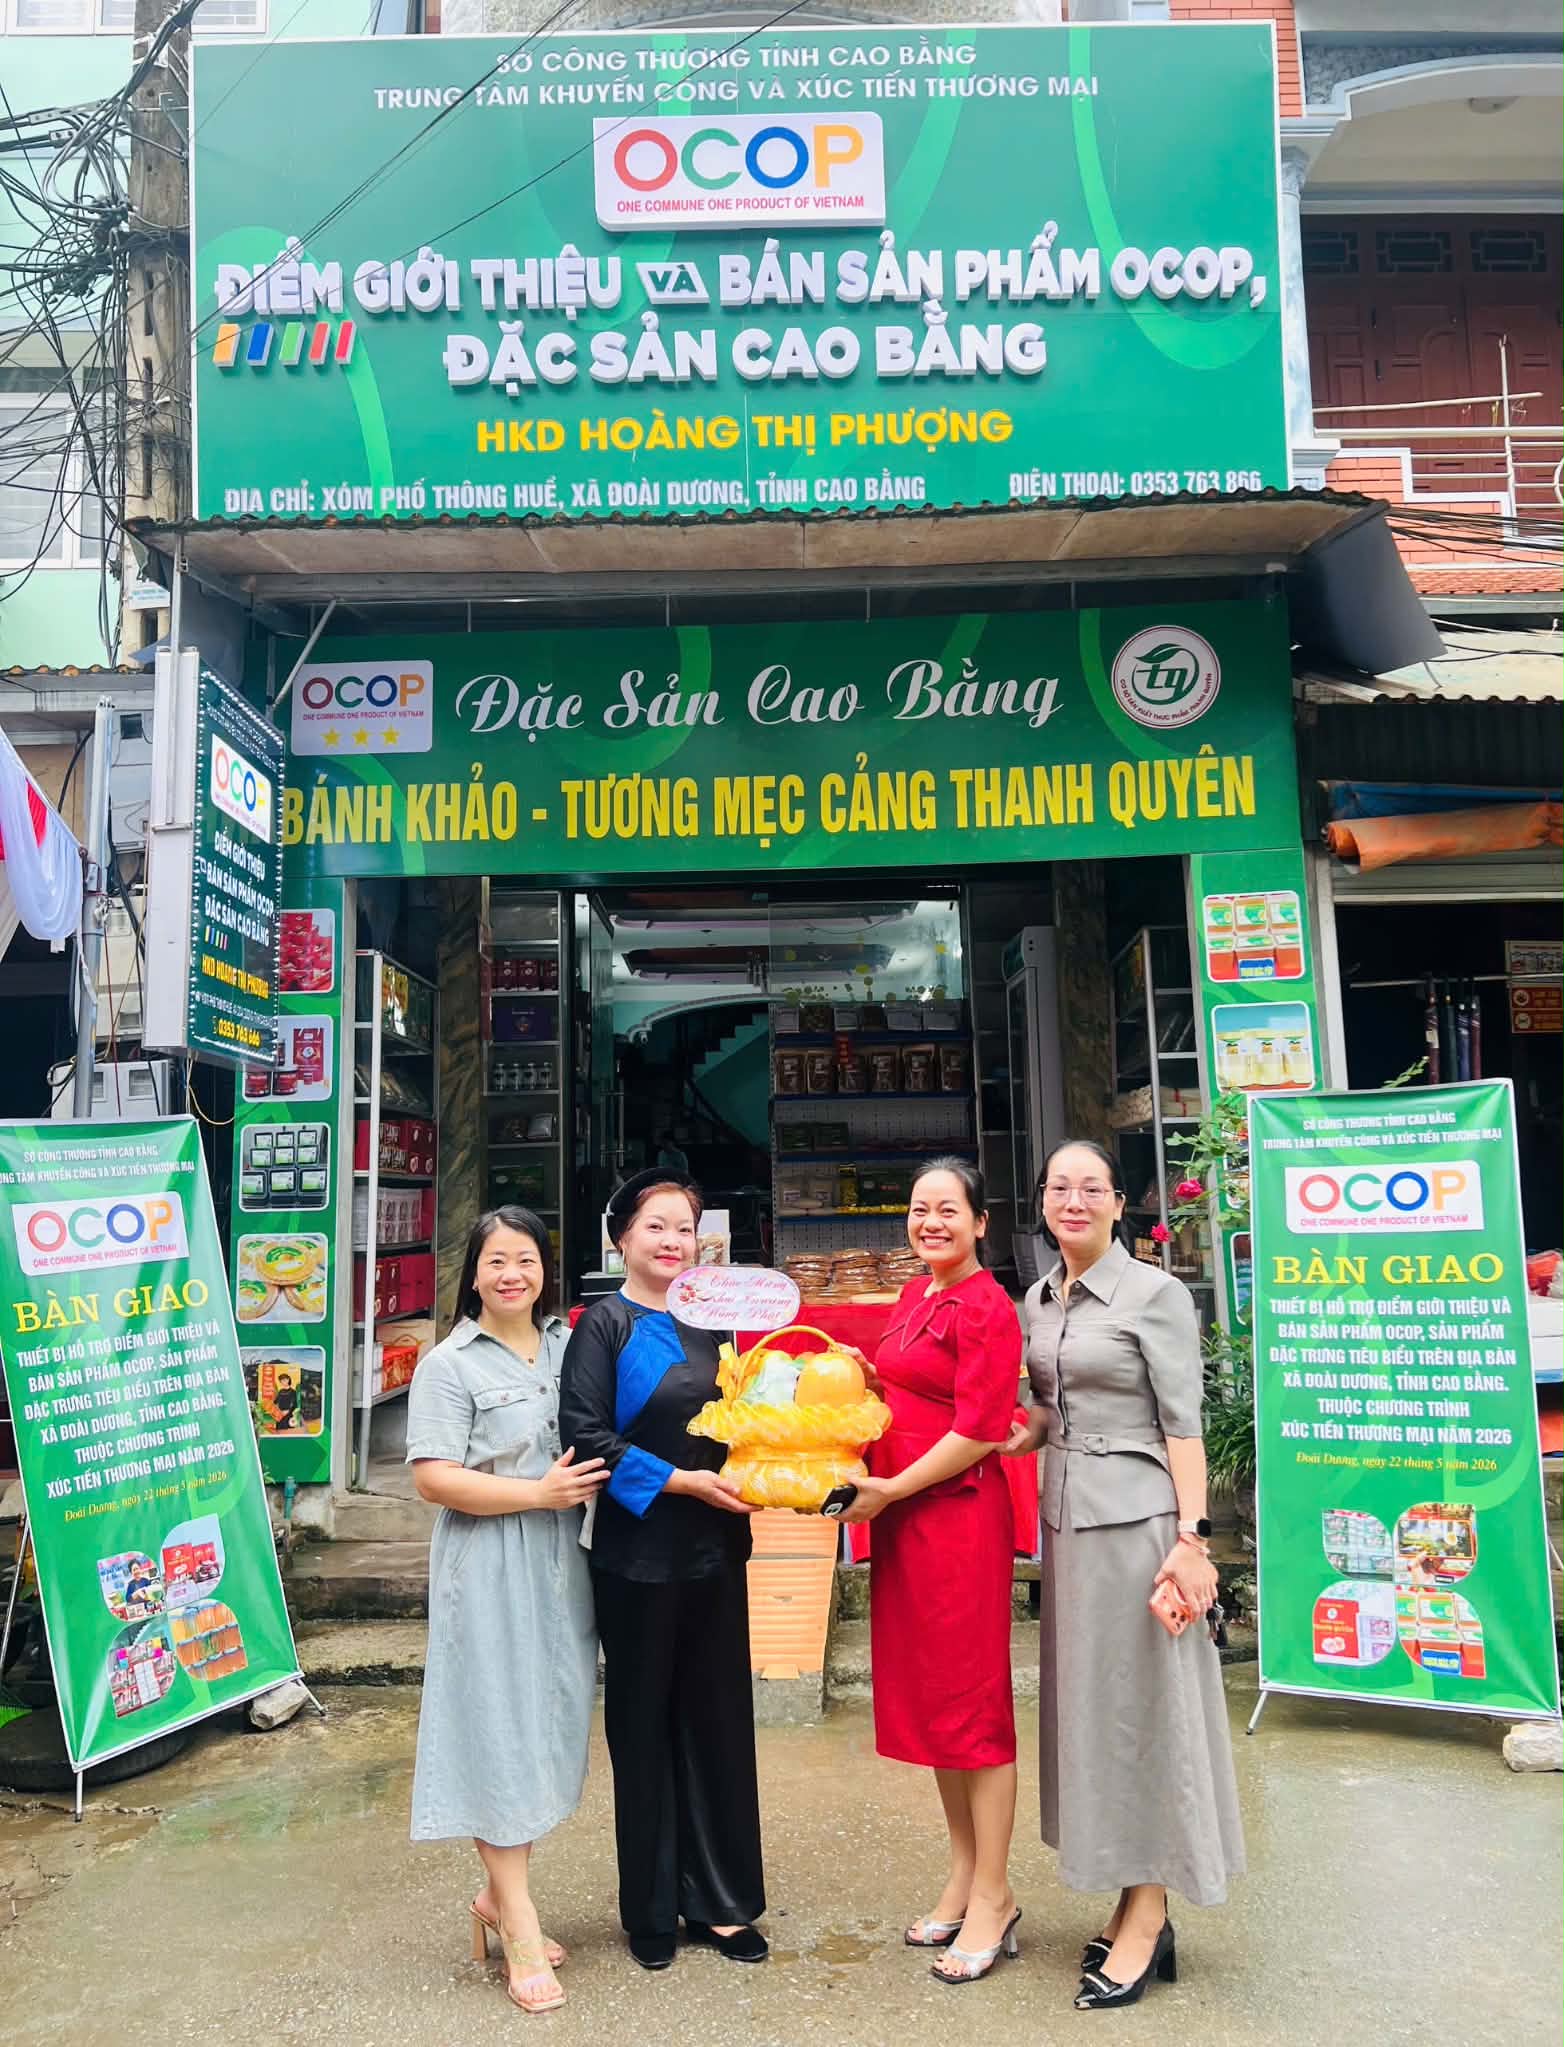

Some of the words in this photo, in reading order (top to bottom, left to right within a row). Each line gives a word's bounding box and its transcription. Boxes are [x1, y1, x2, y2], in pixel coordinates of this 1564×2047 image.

[542, 47, 627, 72] CÔNG
[635, 47, 750, 71] THƯƠNG
[759, 41, 819, 67] TỈNH
[828, 46, 890, 66] CAO
[900, 35, 976, 65] BẰNG
[374, 87, 464, 109] TRUNG
[473, 81, 529, 107] TÂM
[539, 75, 644, 105] KHUYẾN
[654, 79, 738, 102] CÔNG
[748, 74, 784, 99] VÀ
[798, 73, 853, 99] XÚC
[862, 70, 916, 98] TIẾN
[925, 74, 1039, 97] THƯƠNG
[1048, 76, 1098, 102] MẠI
[614, 125, 864, 192] OCOP
[617, 201, 641, 212] ONE
[645, 199, 704, 212] COMMUNE
[708, 198, 732, 211] ONE
[736, 197, 791, 210] PRODUCT
[795, 196, 810, 209] OF
[814, 195, 864, 208] VIETNAM
[214, 236, 343, 316] ĐIỂM
[353, 246, 460, 313] GIỚI
[471, 243, 622, 320] THIỆU
[648, 264, 702, 294] VÀ
[719, 238, 825, 306] BÁN
[836, 230, 944, 303] SẢN
[954, 220, 1100, 301] PHẨM
[1110, 246, 1267, 308] OCOP,
[442, 320, 578, 397] ĐẶC
[589, 311, 718, 385] SẢN
[731, 326, 861, 381] CAO
[875, 297, 1047, 377] BẰNG
[476, 419, 566, 454] HKD
[579, 408, 742, 451] HOÀNG
[752, 414, 816, 456] THỊ
[830, 408, 1014, 454] PHƯỢNG
[270, 479, 315, 512] CHỈ:
[321, 481, 373, 511] XÓM
[380, 477, 426, 510] PHỐ
[432, 479, 507, 509] THÔNG
[571, 478, 602, 507] XÃ
[607, 477, 660, 506] ĐOÀI
[666, 478, 750, 507] DƯƠNG,
[756, 471, 807, 505] TỈNH
[814, 477, 858, 502] CAO
[864, 467, 926, 501] BẰNG
[1130, 471, 1178, 495] 0353
[1184, 470, 1220, 493] 763
[302, 674, 425, 709] OCOP
[455, 673, 585, 743] Đặc
[603, 669, 726, 730] Sản
[747, 664, 865, 725] Cao
[886, 656, 1064, 729] Bằng
[283, 773, 393, 846] BÁNH
[406, 762, 518, 843] KHẢO
[532, 808, 548, 822] -
[560, 772, 698, 840] TƯƠNG
[713, 774, 805, 849] MẸC
[820, 751, 936, 834] CẢNG
[949, 762, 1094, 828] THANH
[1108, 743, 1256, 829] QUYÊN
[214, 826, 232, 859] ĐIỂM
[232, 842, 246, 869] GIỚI
[247, 854, 266, 882] THIỆU
[206, 860, 223, 889] BÁN
[223, 866, 238, 897] SẢN
[257, 893, 275, 923] OCOP,
[205, 894, 221, 923] ĐẶC
[222, 899, 236, 930] SẢN
[236, 913, 251, 938] CAO
[251, 913, 269, 947] BẰNG
[1298, 1170, 1466, 1213] OCOP
[27, 1199, 174, 1253] OCOP
[1272, 1247, 1368, 1284] BÀN
[1382, 1252, 1504, 1284] GIAO
[12, 1289, 101, 1333] BÀN
[113, 1279, 209, 1318] GIAO
[1270, 1295, 1306, 1315] THIẾT
[1309, 1299, 1323, 1317] BỊ
[1349, 1299, 1375, 1318] TRỢ
[1377, 1295, 1413, 1315] ĐIỂM
[1416, 1296, 1445, 1315] GIỚI
[1448, 1296, 1489, 1318] THIỆU
[1491, 1295, 1512, 1314] VÀ
[1278, 1320, 1307, 1338] BÁN
[1309, 1320, 1339, 1339] SẢN
[1341, 1318, 1382, 1340] PHẨM
[1385, 1324, 1425, 1342] OCOP,
[1428, 1319, 1458, 1340] SẢN
[1461, 1318, 1505, 1340] PHẨM
[1269, 1344, 1297, 1366] ĐẶC
[1300, 1347, 1345, 1364] TRƯNG
[1348, 1346, 1378, 1365] TIÊU
[1417, 1346, 1454, 1365] TRÊN
[1456, 1349, 1482, 1369] ĐỊA
[1485, 1346, 1516, 1365] BÀN
[1283, 1369, 1302, 1387] XÃ
[1304, 1370, 1337, 1389] ĐOÀI
[1340, 1373, 1393, 1392] DƯƠNG,
[1395, 1370, 1429, 1391] TỈNH
[1431, 1375, 1461, 1392] CAO
[1463, 1370, 1510, 1392] BẰNG.
[40, 1423, 59, 1445] XÃ
[59, 1418, 89, 1441] ĐOÀI
[91, 1411, 137, 1434] DƯƠNG,
[138, 1402, 166, 1424] TỈNH
[167, 1399, 190, 1417] CAO
[1316, 1395, 1363, 1418] THUỘC
[1365, 1398, 1424, 1416] CHƯƠNG
[1426, 1398, 1470, 1418] TRÌNH
[74, 1440, 114, 1465] THUỘC
[116, 1430, 165, 1455] CHƯƠNG
[166, 1422, 201, 1442] TRÌNH
[1281, 1419, 1309, 1438] XÚC
[1312, 1418, 1343, 1440] TIẾN
[1346, 1423, 1403, 1442] THƯƠNG
[1405, 1425, 1434, 1446] MẠI
[1437, 1424, 1472, 1444] NĂM
[1475, 1428, 1512, 1445] 2026
[46, 1477, 72, 1499] XÚC
[73, 1468, 102, 1492] TIẾN
[103, 1458, 151, 1485] THƯƠNG
[153, 1453, 176, 1473] MẠI
[178, 1445, 205, 1466] NĂM
[207, 1439, 235, 1459] 2026
